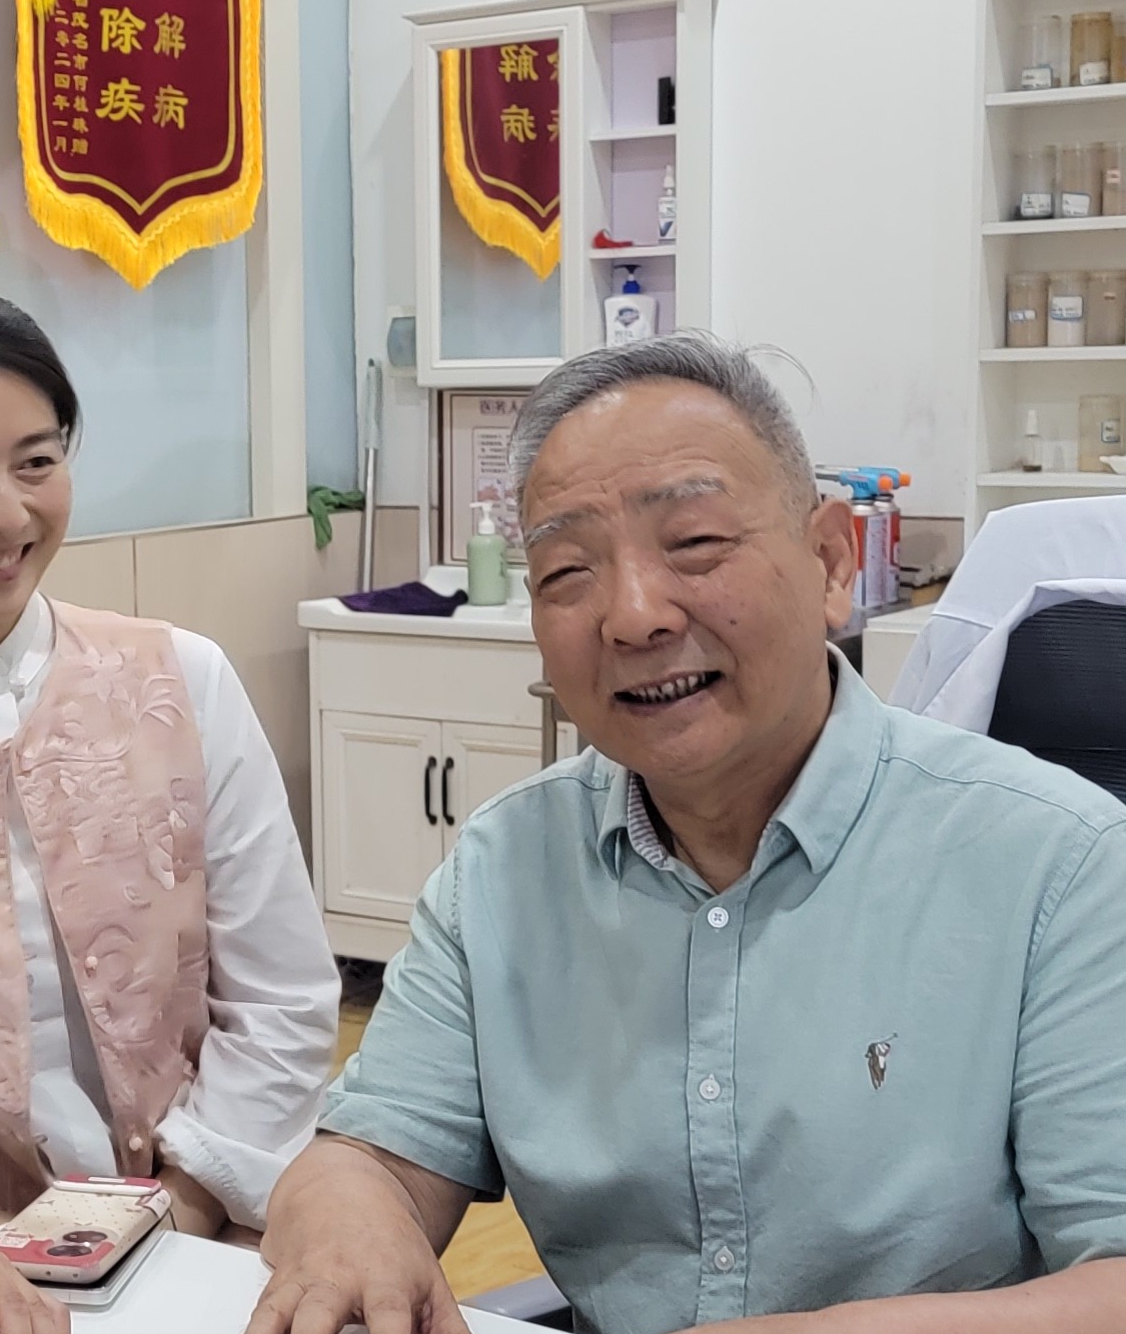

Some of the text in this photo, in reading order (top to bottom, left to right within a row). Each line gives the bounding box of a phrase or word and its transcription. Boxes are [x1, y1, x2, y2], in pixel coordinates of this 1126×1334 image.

[52, 9, 71, 153] 二零二四年一月
